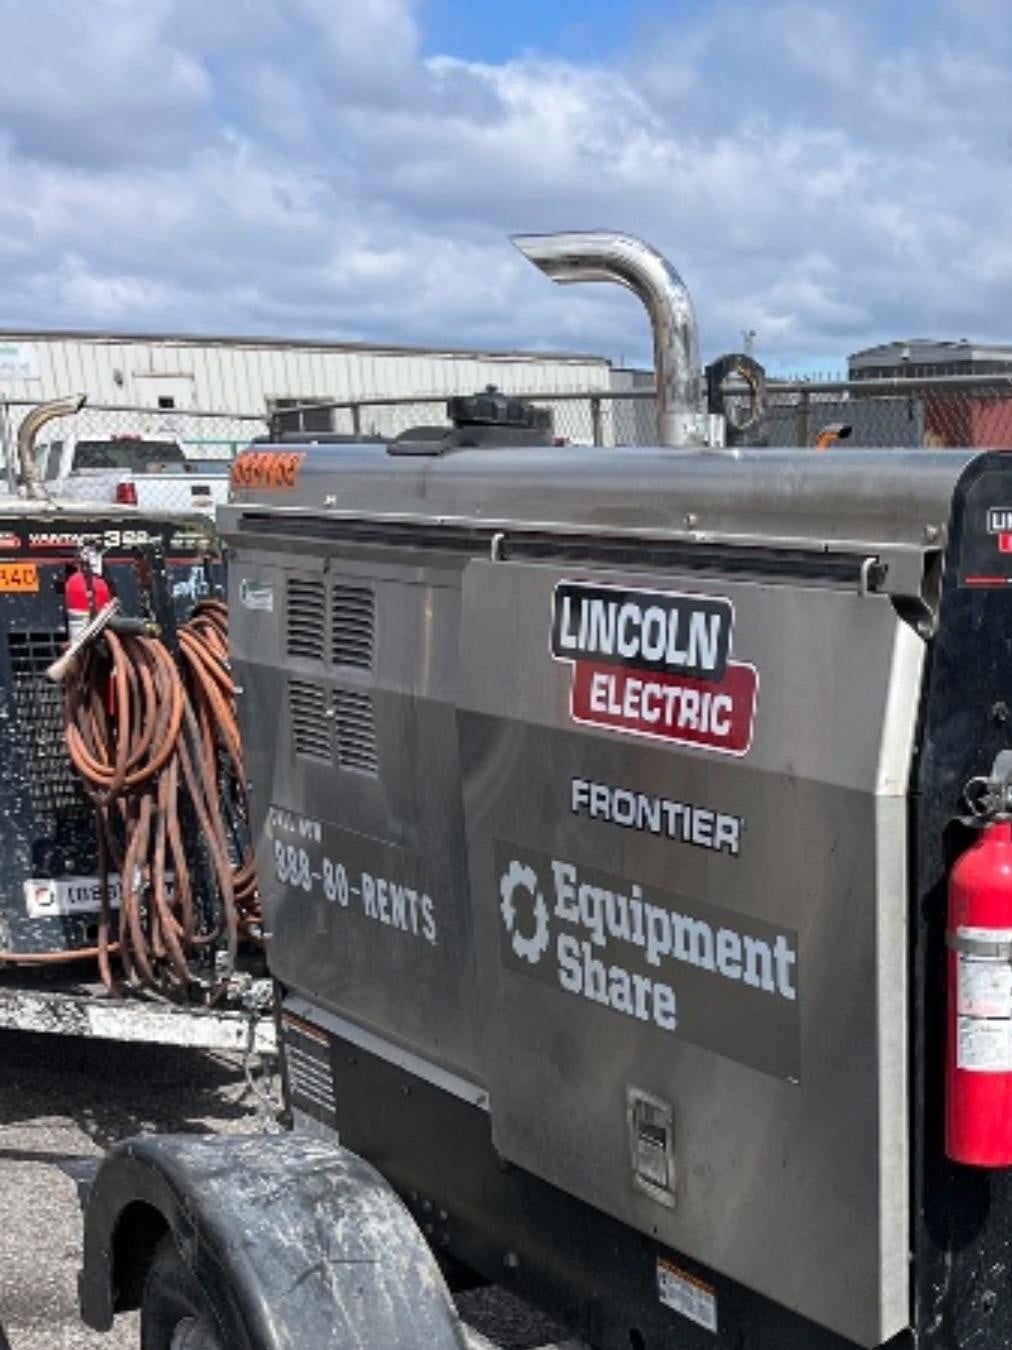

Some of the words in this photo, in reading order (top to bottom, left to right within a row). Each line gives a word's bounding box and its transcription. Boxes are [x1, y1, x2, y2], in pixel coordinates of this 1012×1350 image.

[560, 597, 721, 670] LINCOLN
[590, 672, 733, 736] ELECTRIC
[571, 778, 741, 855] FRONTIER
[551, 859, 797, 1000] Equipment
[557, 932, 678, 1031] Share
